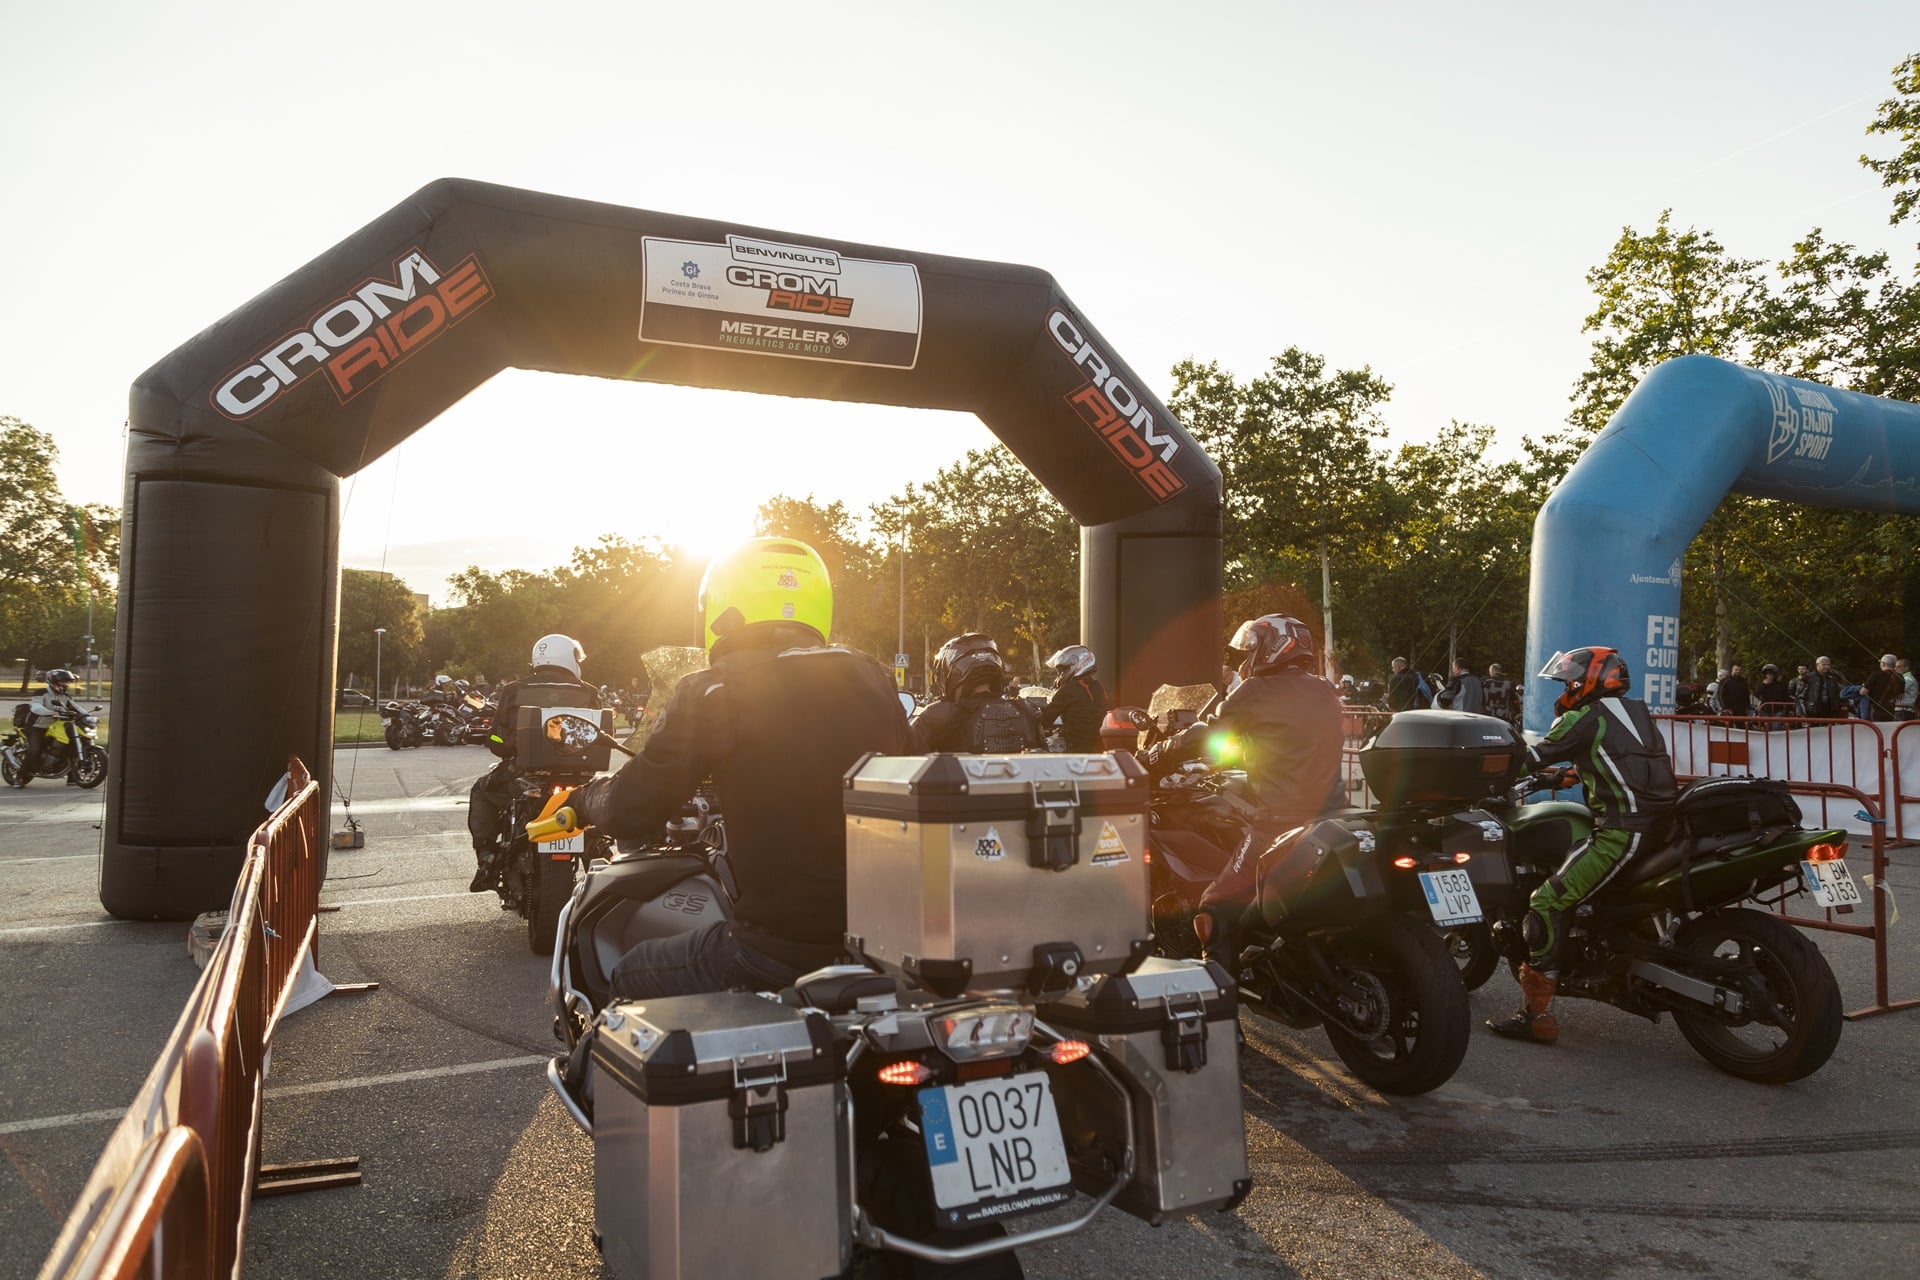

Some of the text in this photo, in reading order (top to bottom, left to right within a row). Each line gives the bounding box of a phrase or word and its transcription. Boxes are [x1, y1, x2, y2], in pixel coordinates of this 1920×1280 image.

[735, 245, 836, 267] BENVINGUTS
[661, 286, 686, 296] Pirineu
[697, 292, 719, 300] Girona
[670, 279, 712, 291] Costa Brava
[727, 266, 838, 297] CROM
[768, 290, 853, 317] RIDE
[216, 252, 440, 415] CROM
[327, 261, 489, 394] RIDE
[720, 320, 830, 344] METZELER
[788, 341, 801, 351] DE
[803, 343, 832, 354] MOTO
[1049, 311, 1179, 463] CROM
[1801, 407, 1833, 435] ENJOY
[1072, 385, 1183, 499] RIDE
[1794, 432, 1833, 460] SPORT
[978, 839, 997, 849] 100
[1435, 873, 1471, 894] 1583
[1812, 861, 1850, 882] Z BM
[663, 889, 710, 916] GS
[1444, 894, 1471, 915] LVP
[1822, 881, 1858, 903] 3153
[958, 1082, 1043, 1138] 0037
[934, 1133, 947, 1151] E
[965, 1136, 1037, 1193] LNB
